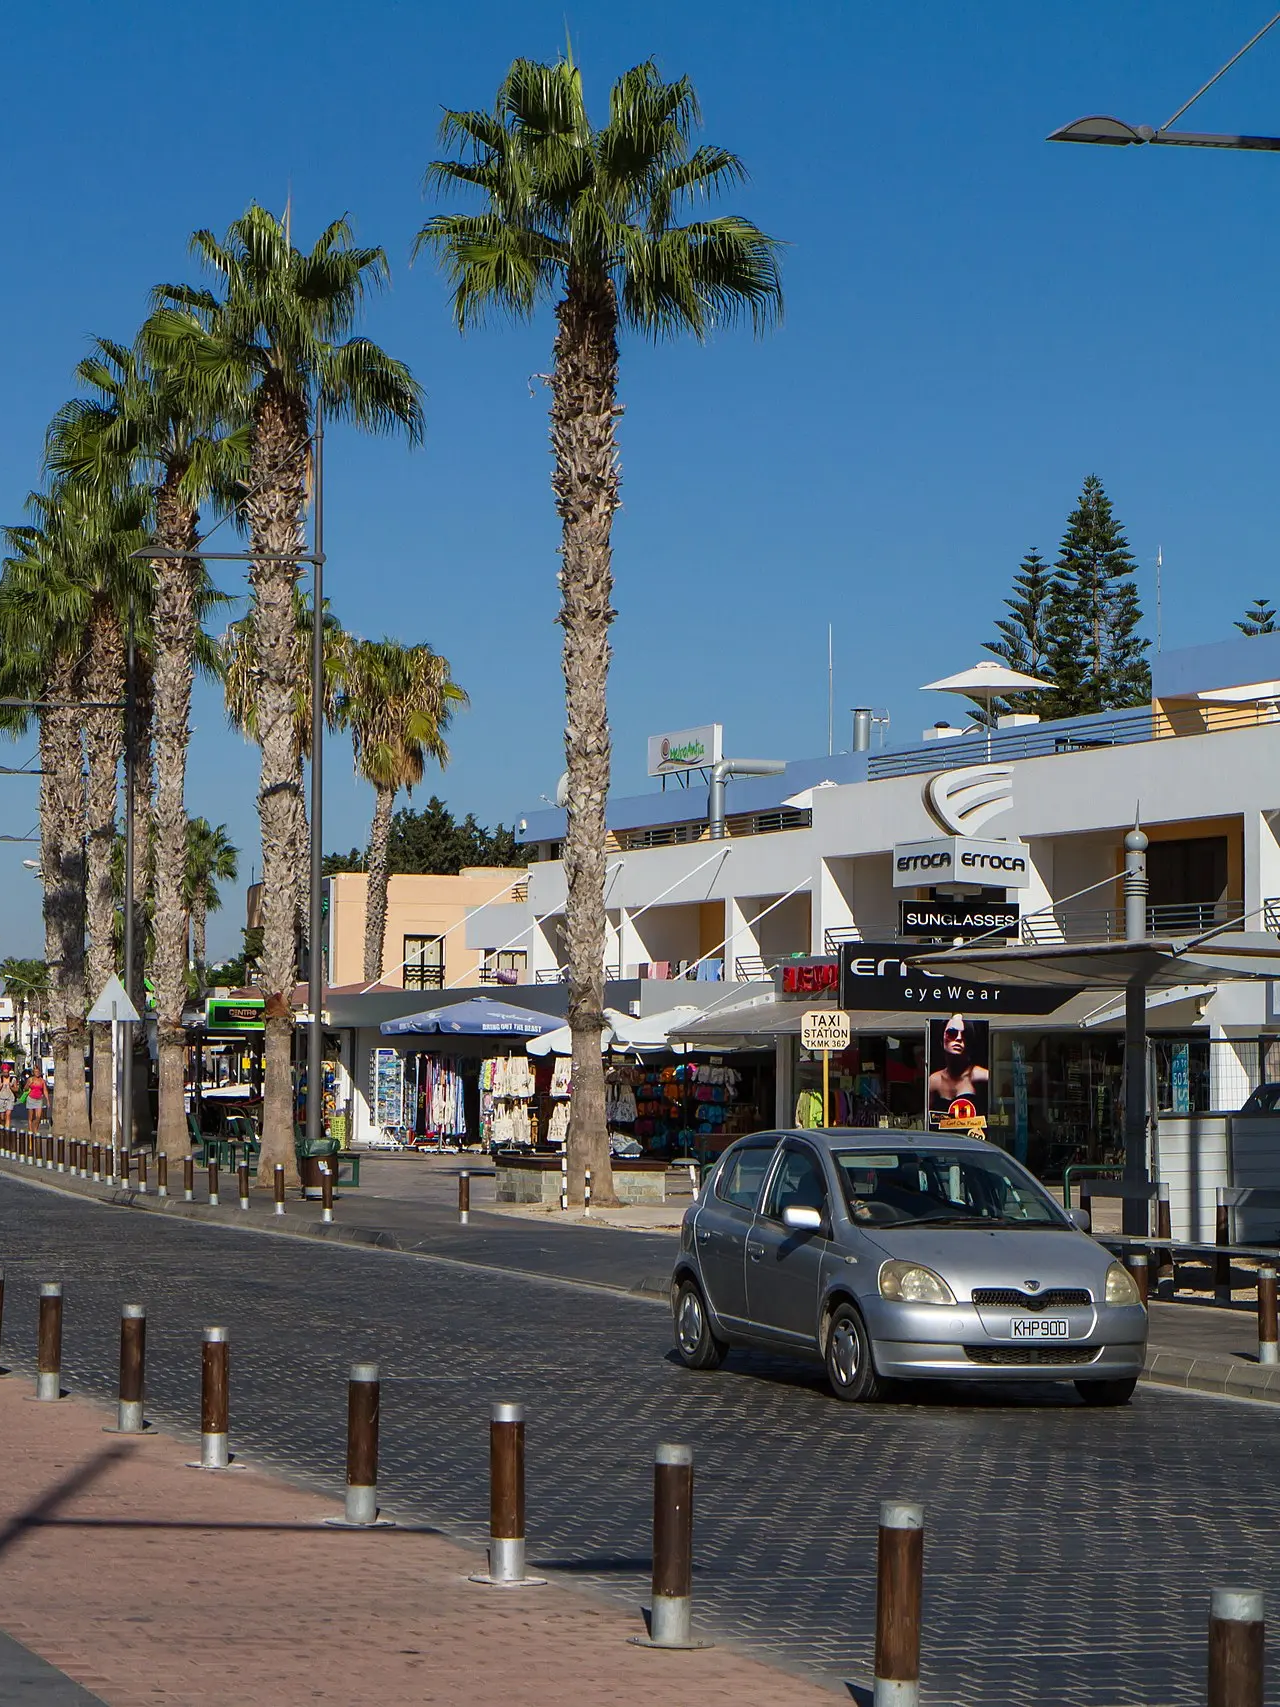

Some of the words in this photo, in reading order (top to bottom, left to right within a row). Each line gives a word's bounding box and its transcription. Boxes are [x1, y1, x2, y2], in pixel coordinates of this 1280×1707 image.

[906, 912, 1015, 928] SUNGLASSES
[904, 986, 1000, 1002] eyeWear
[810, 1014, 840, 1027] TAXI
[500, 1023, 513, 1031] OUT
[524, 1024, 542, 1033] BEAST
[803, 1029, 848, 1039] STATION
[805, 1040, 830, 1048] TKMK
[831, 1040, 846, 1048] 362
[1013, 1320, 1067, 1337] KHP900
